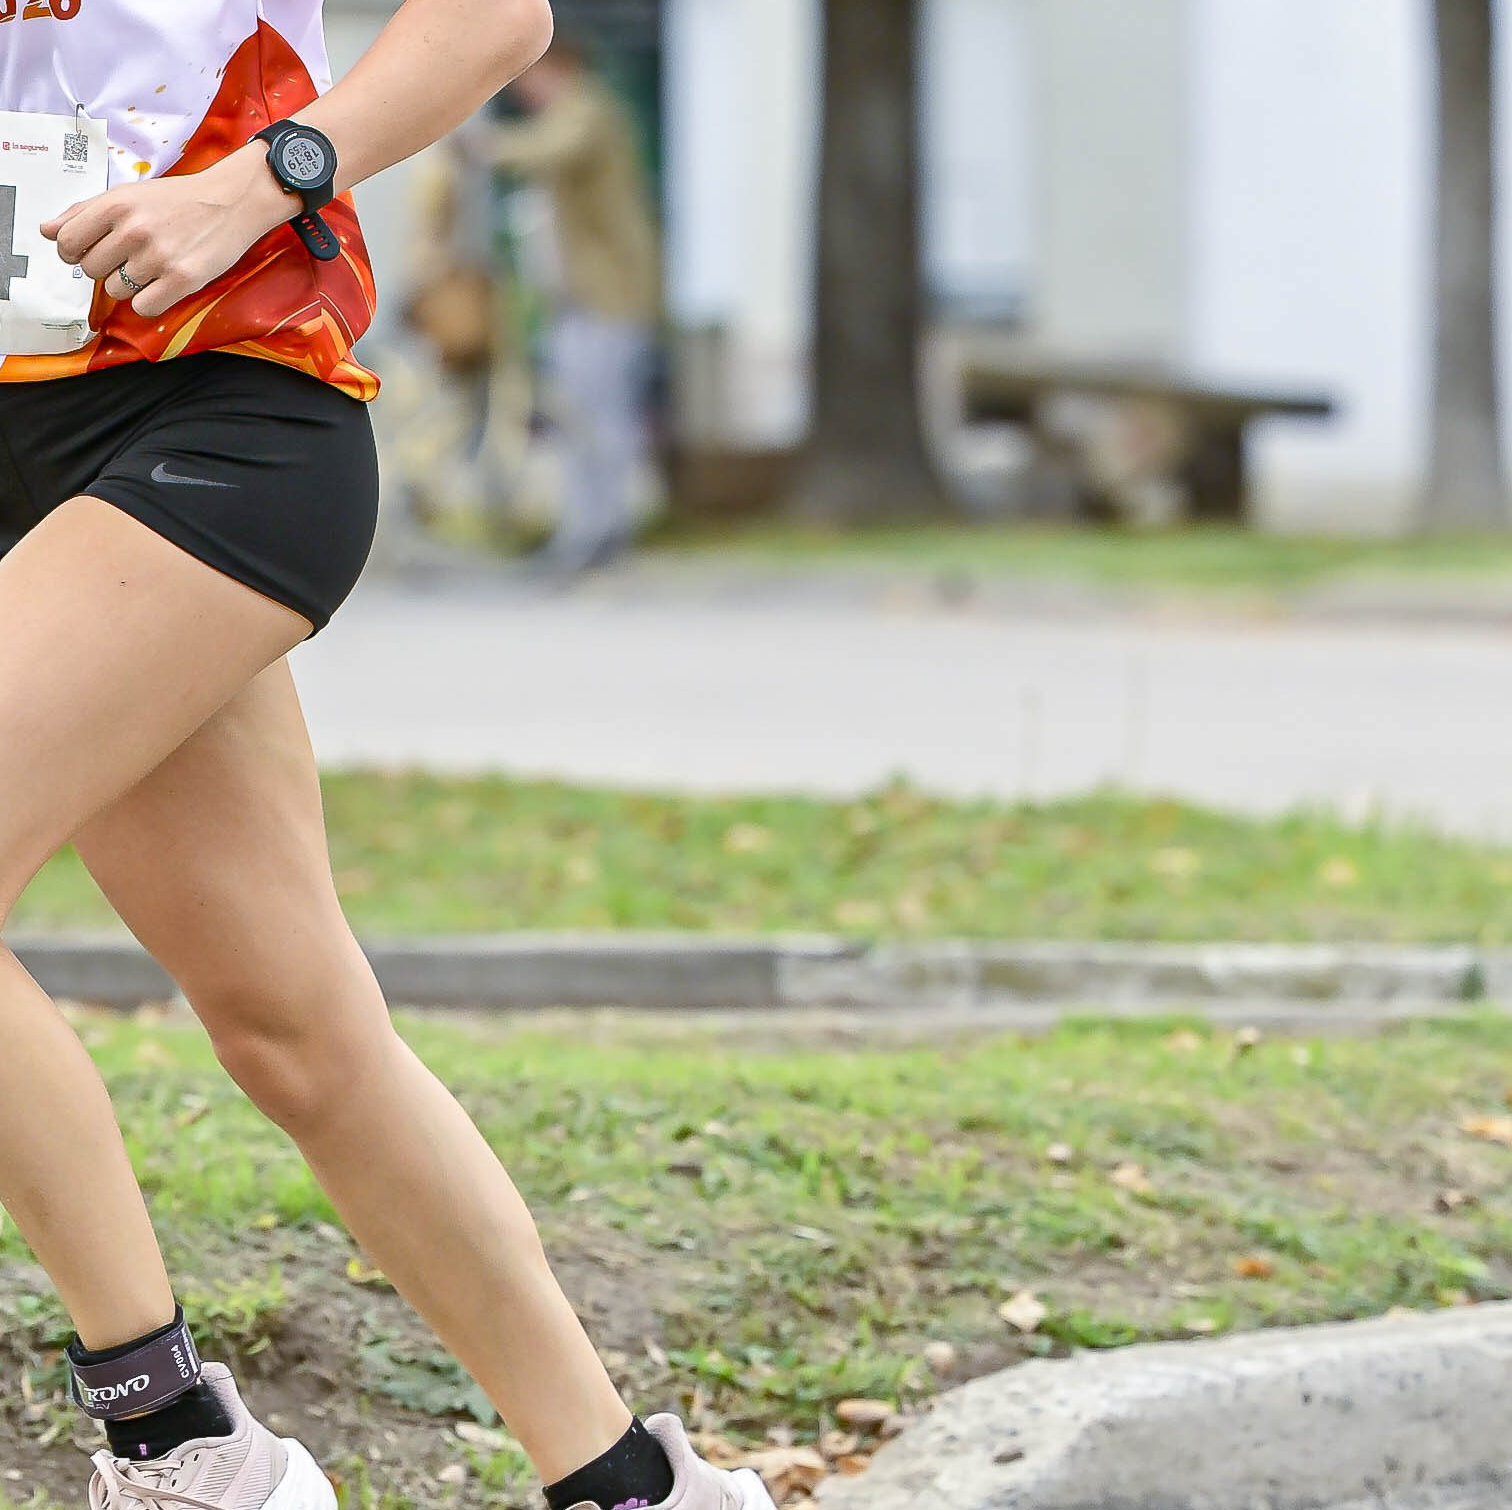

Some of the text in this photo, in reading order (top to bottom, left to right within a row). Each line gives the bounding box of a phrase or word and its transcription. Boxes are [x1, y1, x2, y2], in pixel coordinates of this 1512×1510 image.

[288, 142, 307, 158] 5:55
[288, 148, 320, 170] 18:19
[171, 1344, 190, 1378] CV004
